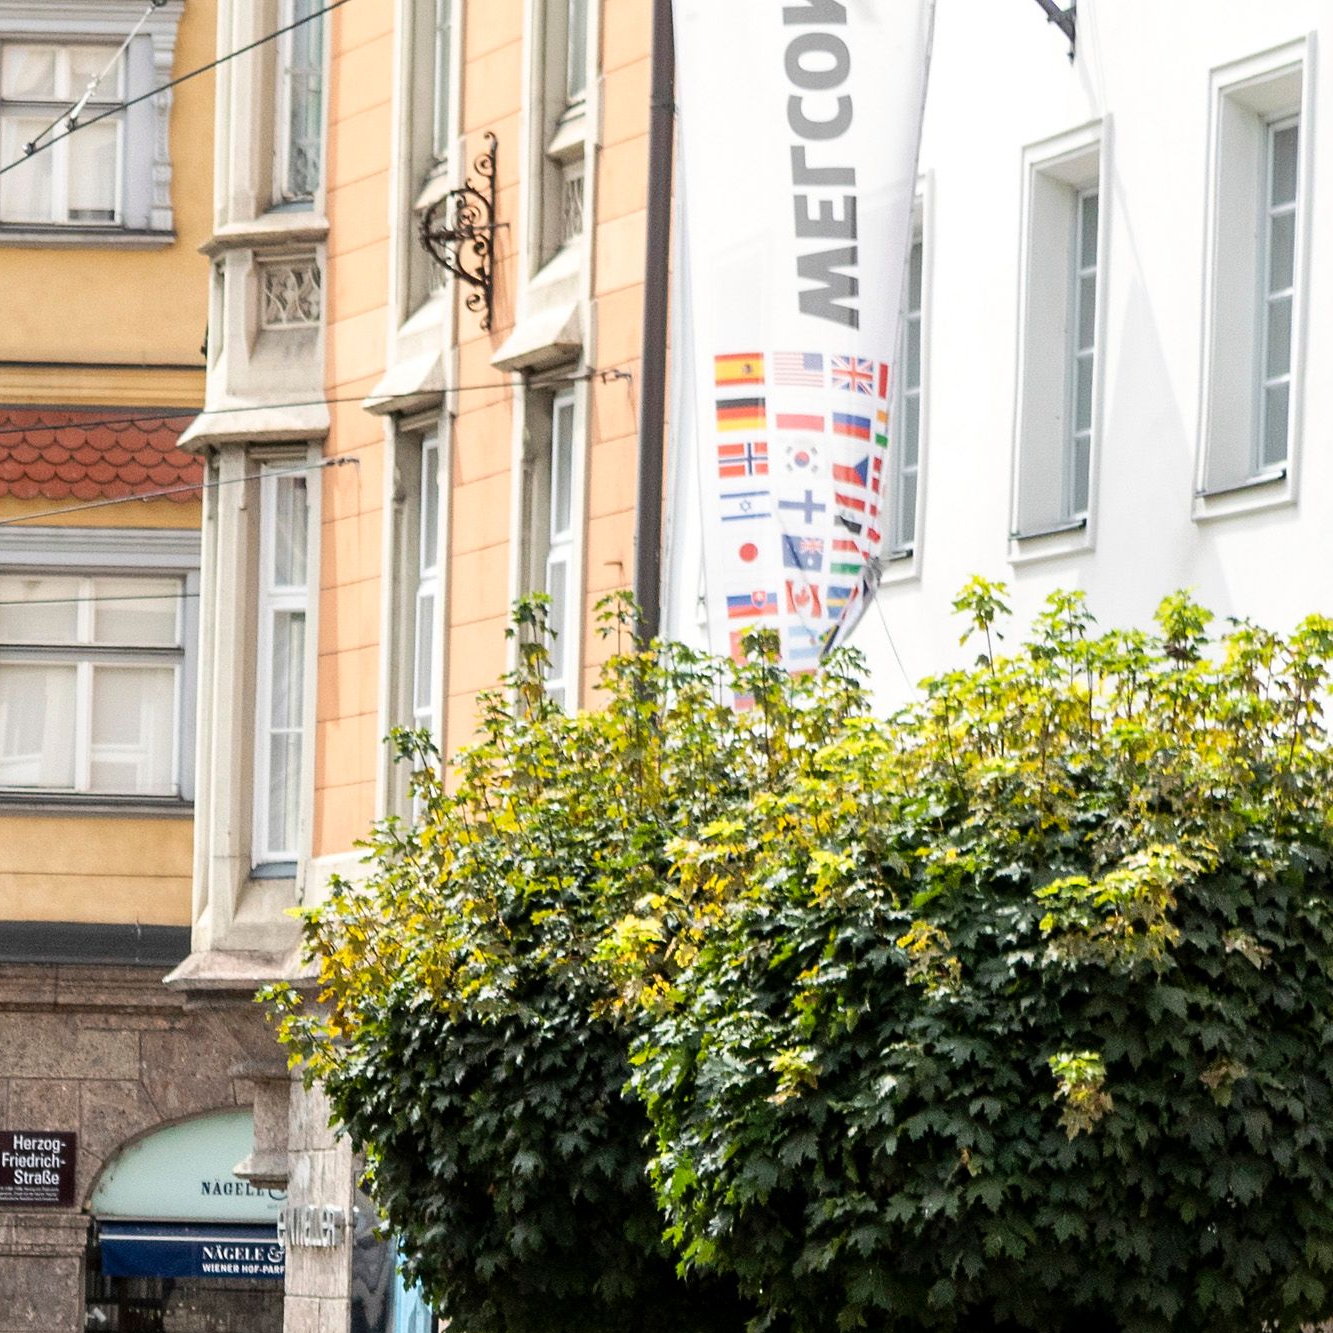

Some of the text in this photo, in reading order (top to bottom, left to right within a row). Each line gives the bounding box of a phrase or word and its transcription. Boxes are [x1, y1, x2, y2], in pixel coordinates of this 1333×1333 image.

[13, 1134, 67, 1154] Herzog-
[1, 1151, 67, 1168] Friedrich-
[14, 1169, 60, 1185] Straße
[201, 1245, 265, 1261] NÄGELE
[202, 1263, 240, 1274] WIENER
